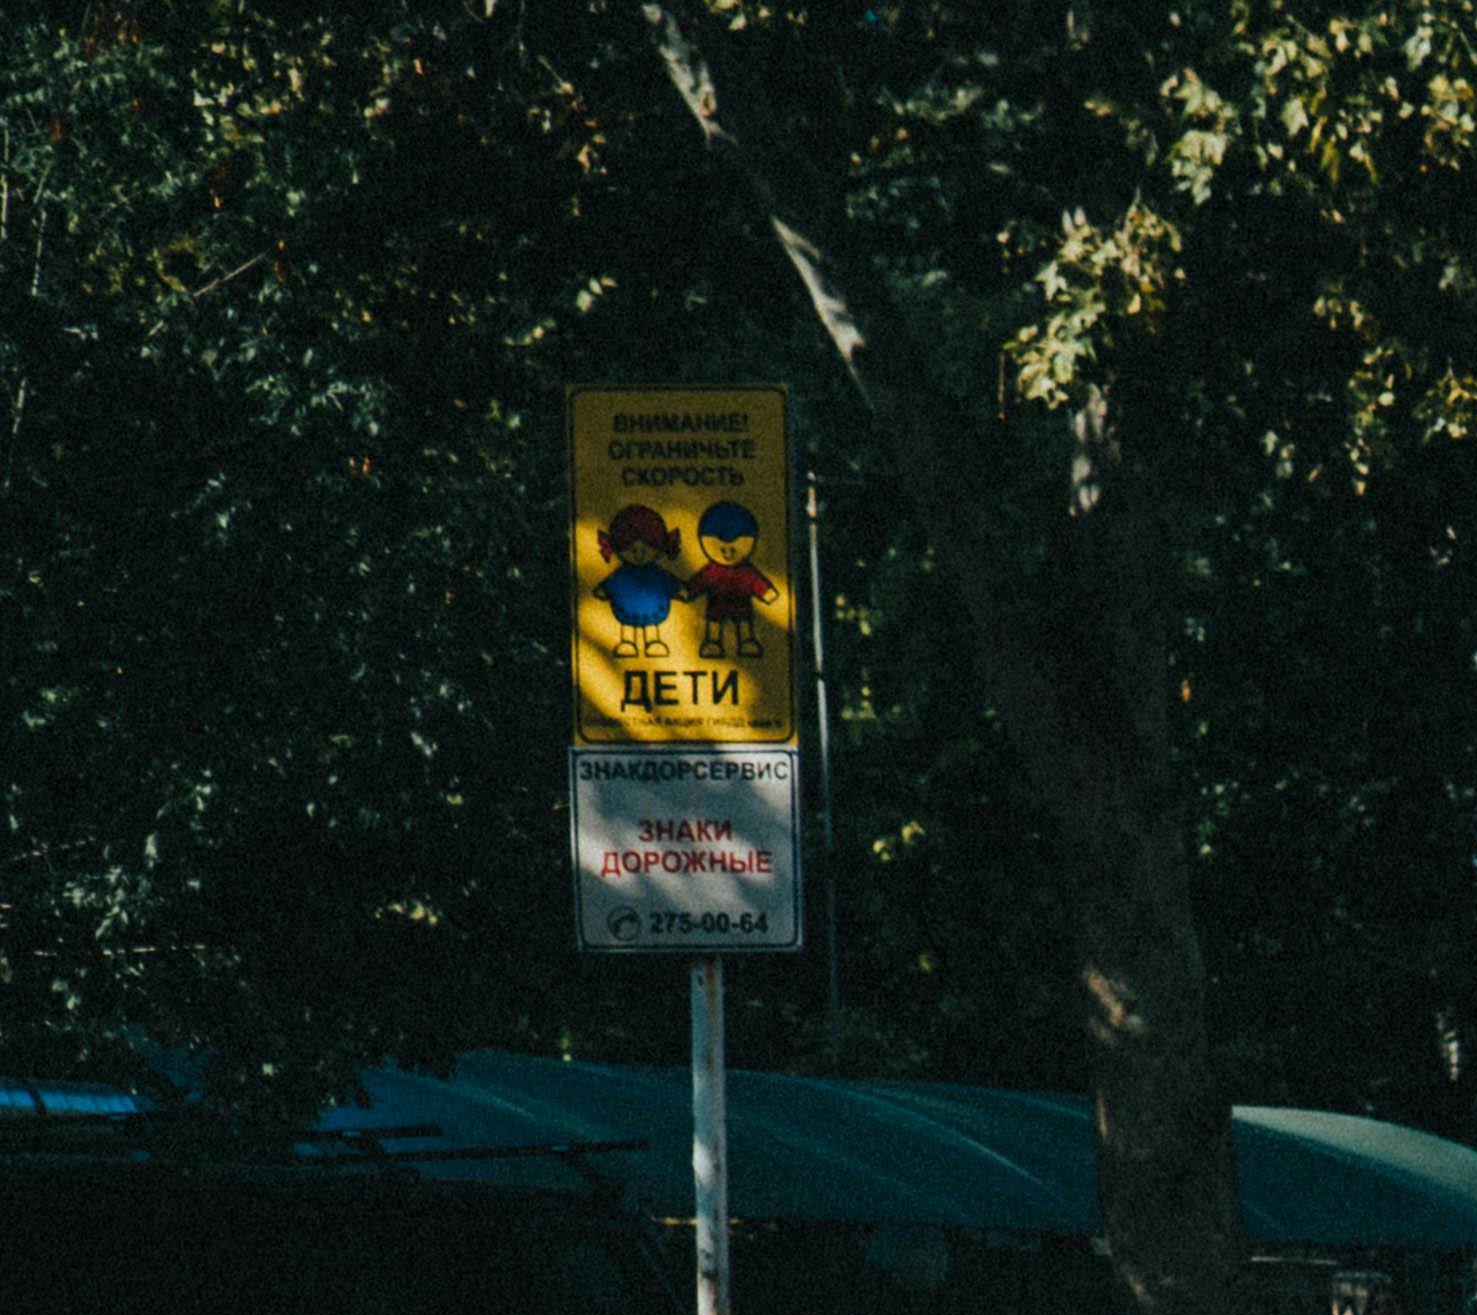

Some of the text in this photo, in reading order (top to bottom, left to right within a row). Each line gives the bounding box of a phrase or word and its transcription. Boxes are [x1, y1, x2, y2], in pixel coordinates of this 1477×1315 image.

[608, 439, 756, 460] ОГРАНИЧЬТЕ
[621, 464, 745, 486] СКОРОСТЬ
[620, 670, 740, 712] ДЕТИ
[579, 761, 788, 781] ЗНАКДОРСЕРВИС
[638, 820, 733, 842] ЗНАКИ
[601, 851, 773, 877] ДОРОЖНЫЕ
[650, 912, 769, 934] 275-00-64
